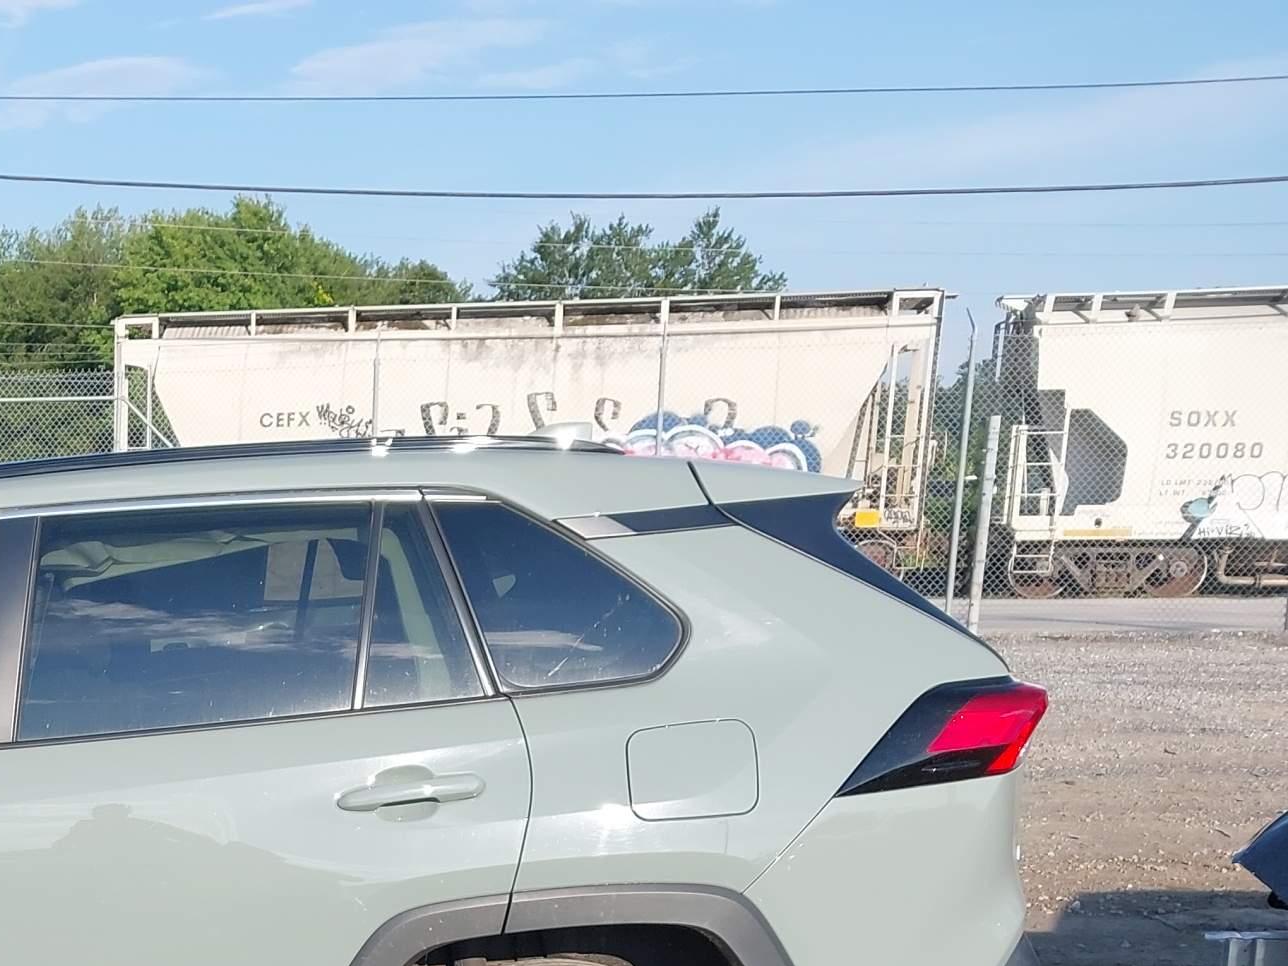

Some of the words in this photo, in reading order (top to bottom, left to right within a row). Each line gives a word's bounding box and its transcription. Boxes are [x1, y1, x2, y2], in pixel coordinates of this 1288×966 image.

[259, 411, 310, 428] CEFX
[1169, 410, 1237, 428] SOXX
[1165, 442, 1264, 460] 320080
